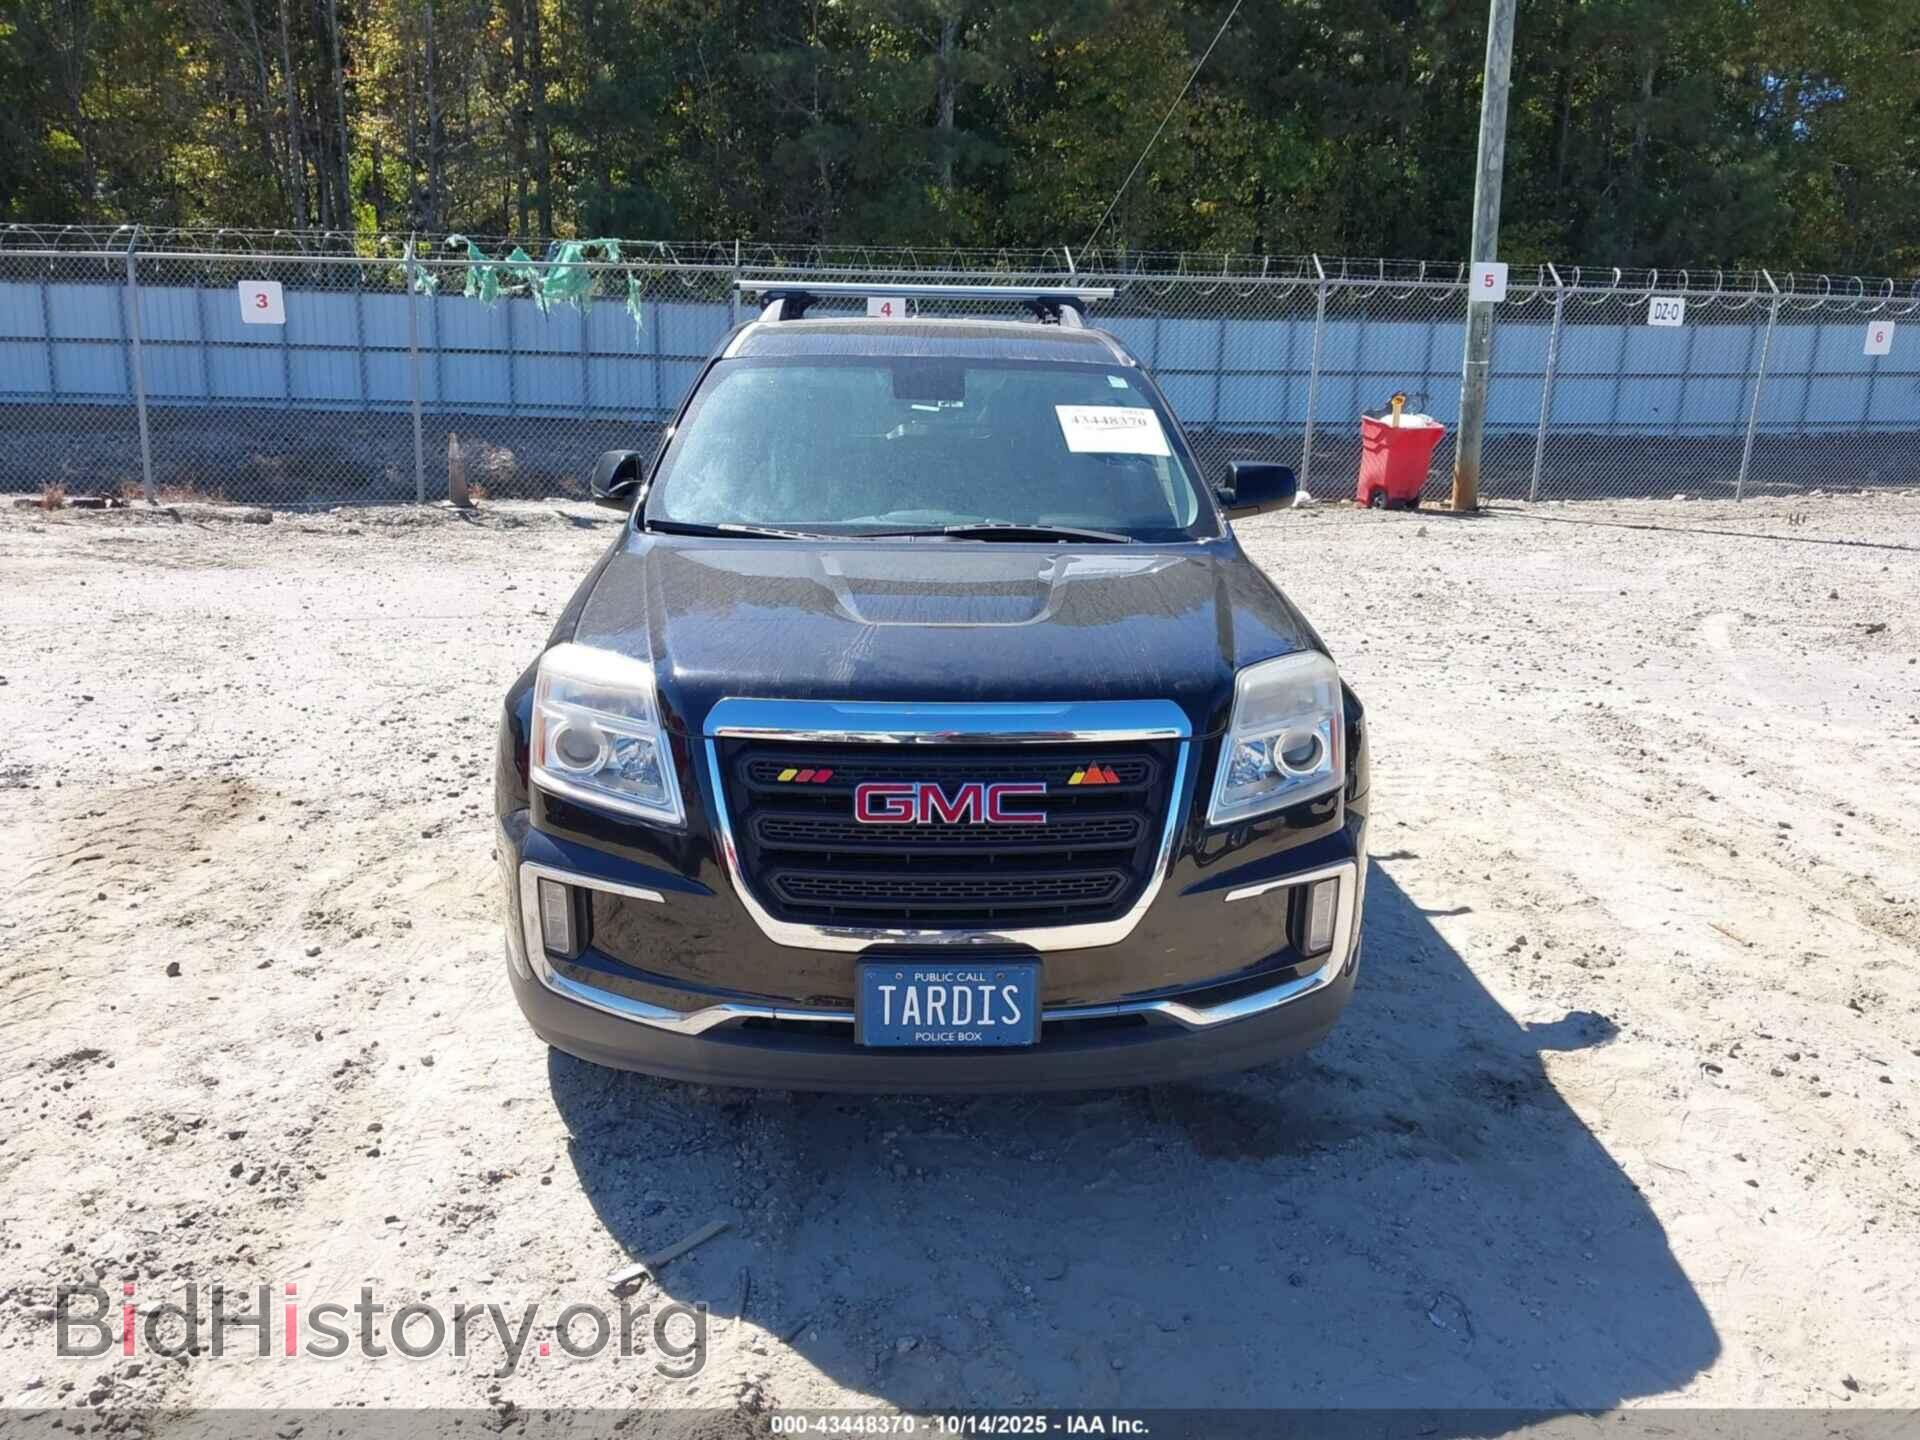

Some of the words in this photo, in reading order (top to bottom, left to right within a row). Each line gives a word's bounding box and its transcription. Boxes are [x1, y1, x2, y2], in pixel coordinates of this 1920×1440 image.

[1484, 274, 1495, 288] 5
[255, 293, 269, 309] 3
[880, 302, 893, 318] 4
[1875, 331, 1884, 343] 6
[855, 782, 1047, 824] GMC
[914, 972, 953, 982] PUBLIC
[956, 972, 986, 982] CALL
[878, 985, 1022, 1026] TARDIS
[915, 1032, 954, 1041] POLICE
[957, 1032, 982, 1041] BOX
